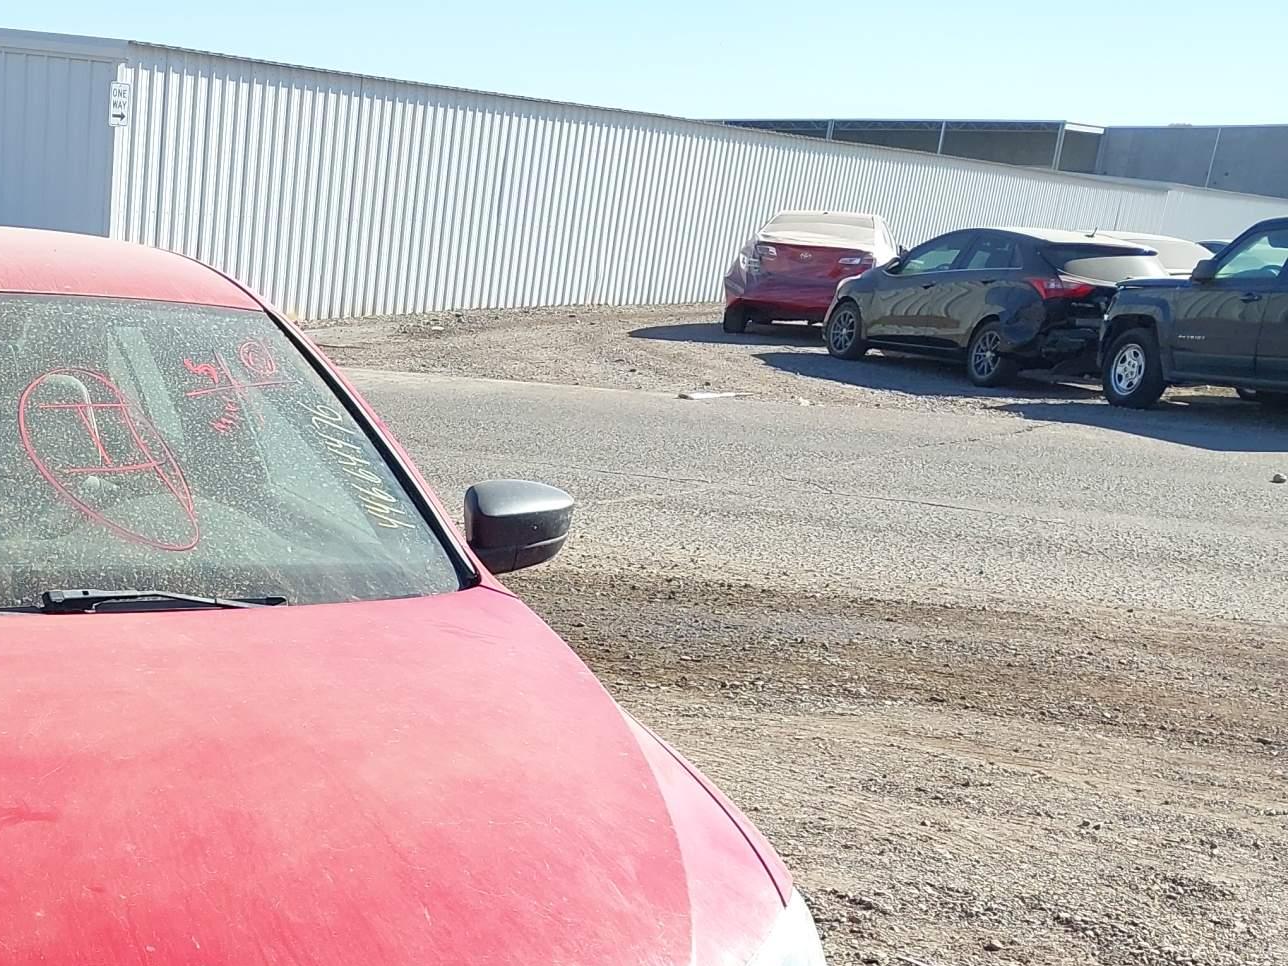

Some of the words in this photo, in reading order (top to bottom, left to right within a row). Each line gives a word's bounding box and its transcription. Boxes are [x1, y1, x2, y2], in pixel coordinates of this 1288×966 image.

[112, 88, 128, 98] ONE
[112, 99, 127, 109] WAY
[296, 400, 416, 529] 44664476
